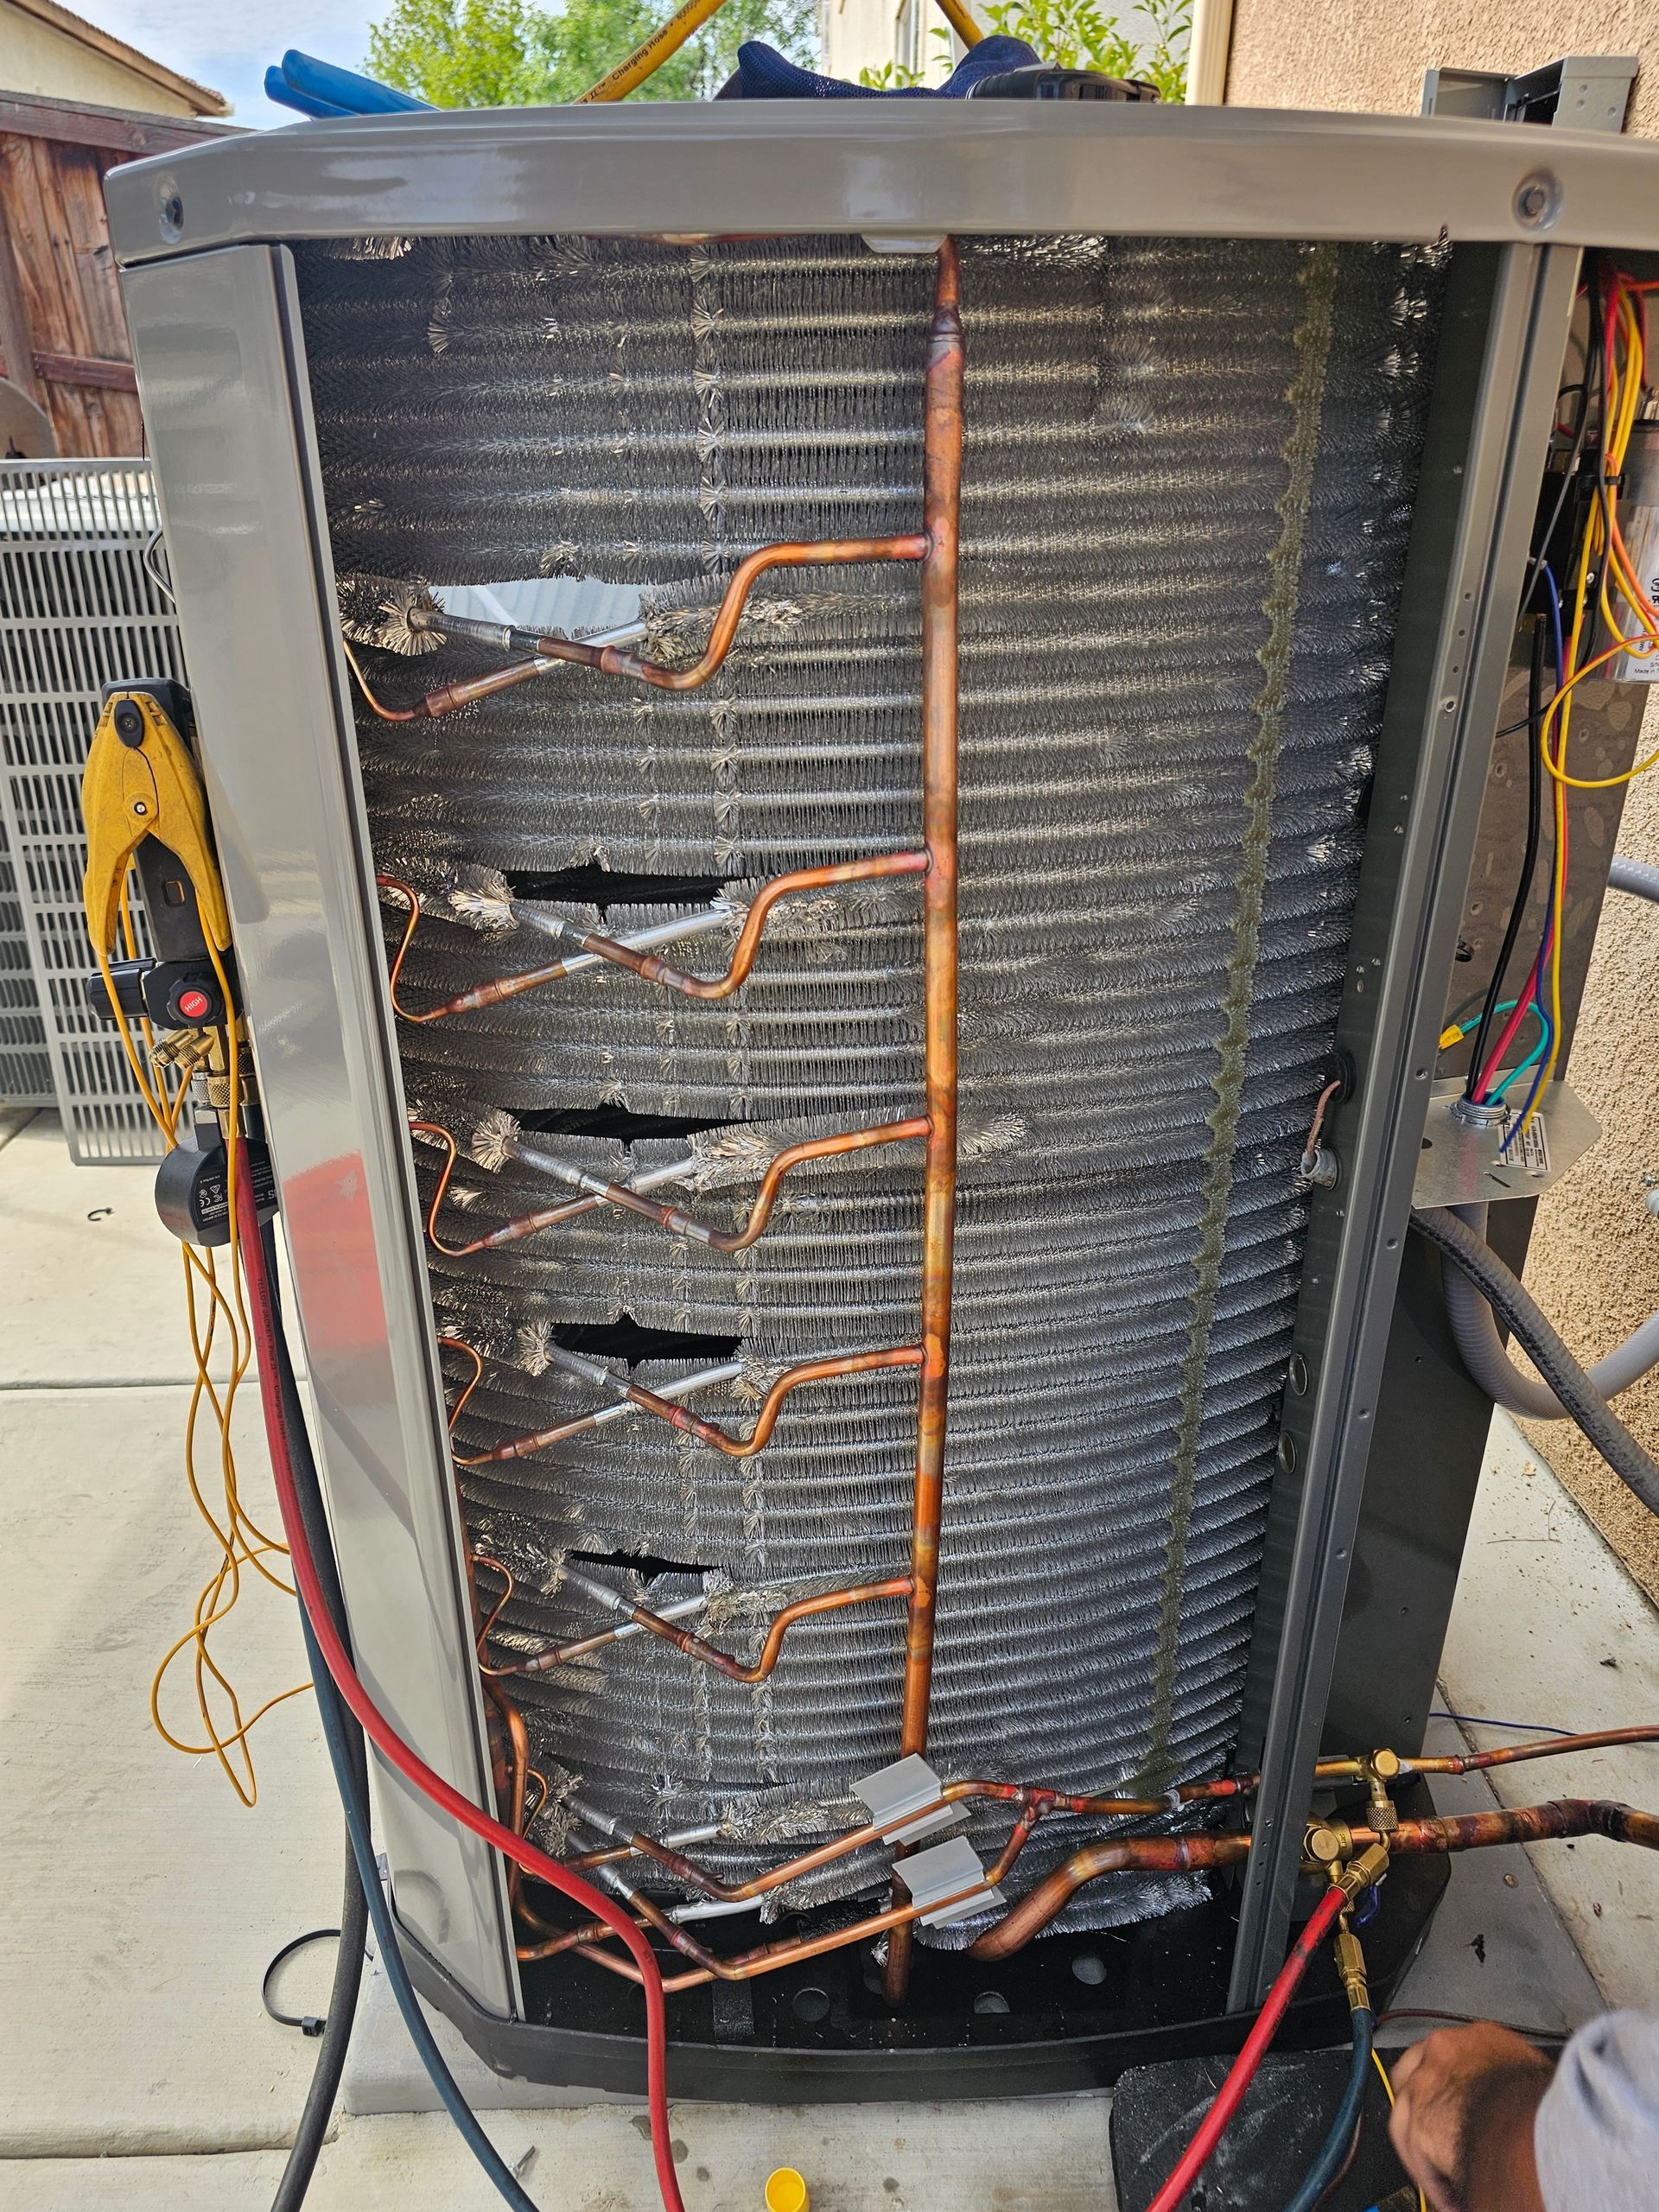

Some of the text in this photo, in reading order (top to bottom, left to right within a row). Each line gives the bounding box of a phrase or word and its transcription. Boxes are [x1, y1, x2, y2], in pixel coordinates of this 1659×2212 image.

[611, 48, 649, 81] Charging
[647, 29, 669, 51] Hose
[184, 996, 203, 1013] HIGH
[257, 1277, 268, 1307] YELLOW
[273, 1384, 283, 1419] Charging
